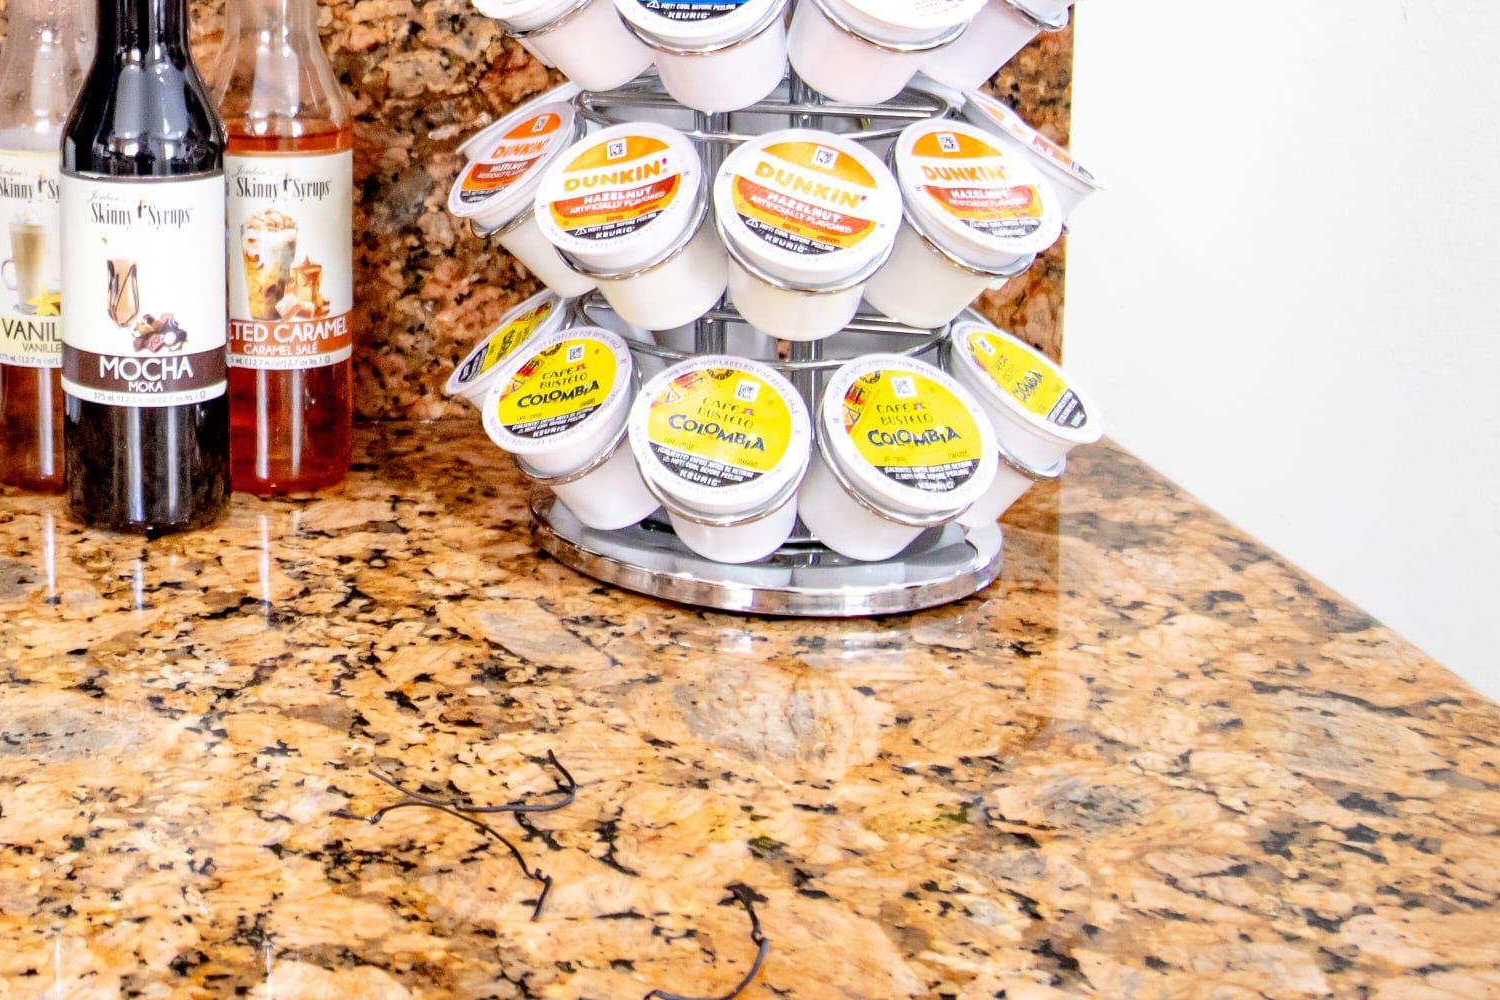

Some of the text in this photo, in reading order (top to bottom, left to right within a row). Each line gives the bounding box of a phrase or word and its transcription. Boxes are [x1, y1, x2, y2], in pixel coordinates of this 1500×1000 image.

[236, 177, 331, 203] Skinny Syrups
[583, 186, 653, 205] HAZELNUT
[569, 200, 624, 215] ARTIFICIALLY
[624, 191, 666, 207] FLAVORED
[767, 191, 842, 223] HAZELNUT
[91, 202, 191, 231] Skinny Syrups
[805, 214, 853, 234] FLAVORED
[596, 227, 634, 239] KEURIG
[764, 233, 806, 253] KEURIG
[273, 315, 348, 343] CARAMEL
[243, 342, 318, 356] CARAMEL SALÉ
[100, 355, 194, 381] MOCHA
[128, 381, 164, 392] MOKA
[540, 373, 588, 389] BUSTELO
[517, 380, 600, 408] COLOMBIA
[697, 406, 754, 429] BUSTELO
[880, 413, 933, 426] BUSTELO
[532, 426, 566, 438] KEURIG
[668, 414, 765, 452] COLOMBIA
[867, 426, 962, 447] COLOMBIA
[680, 468, 719, 486] KEURIG
